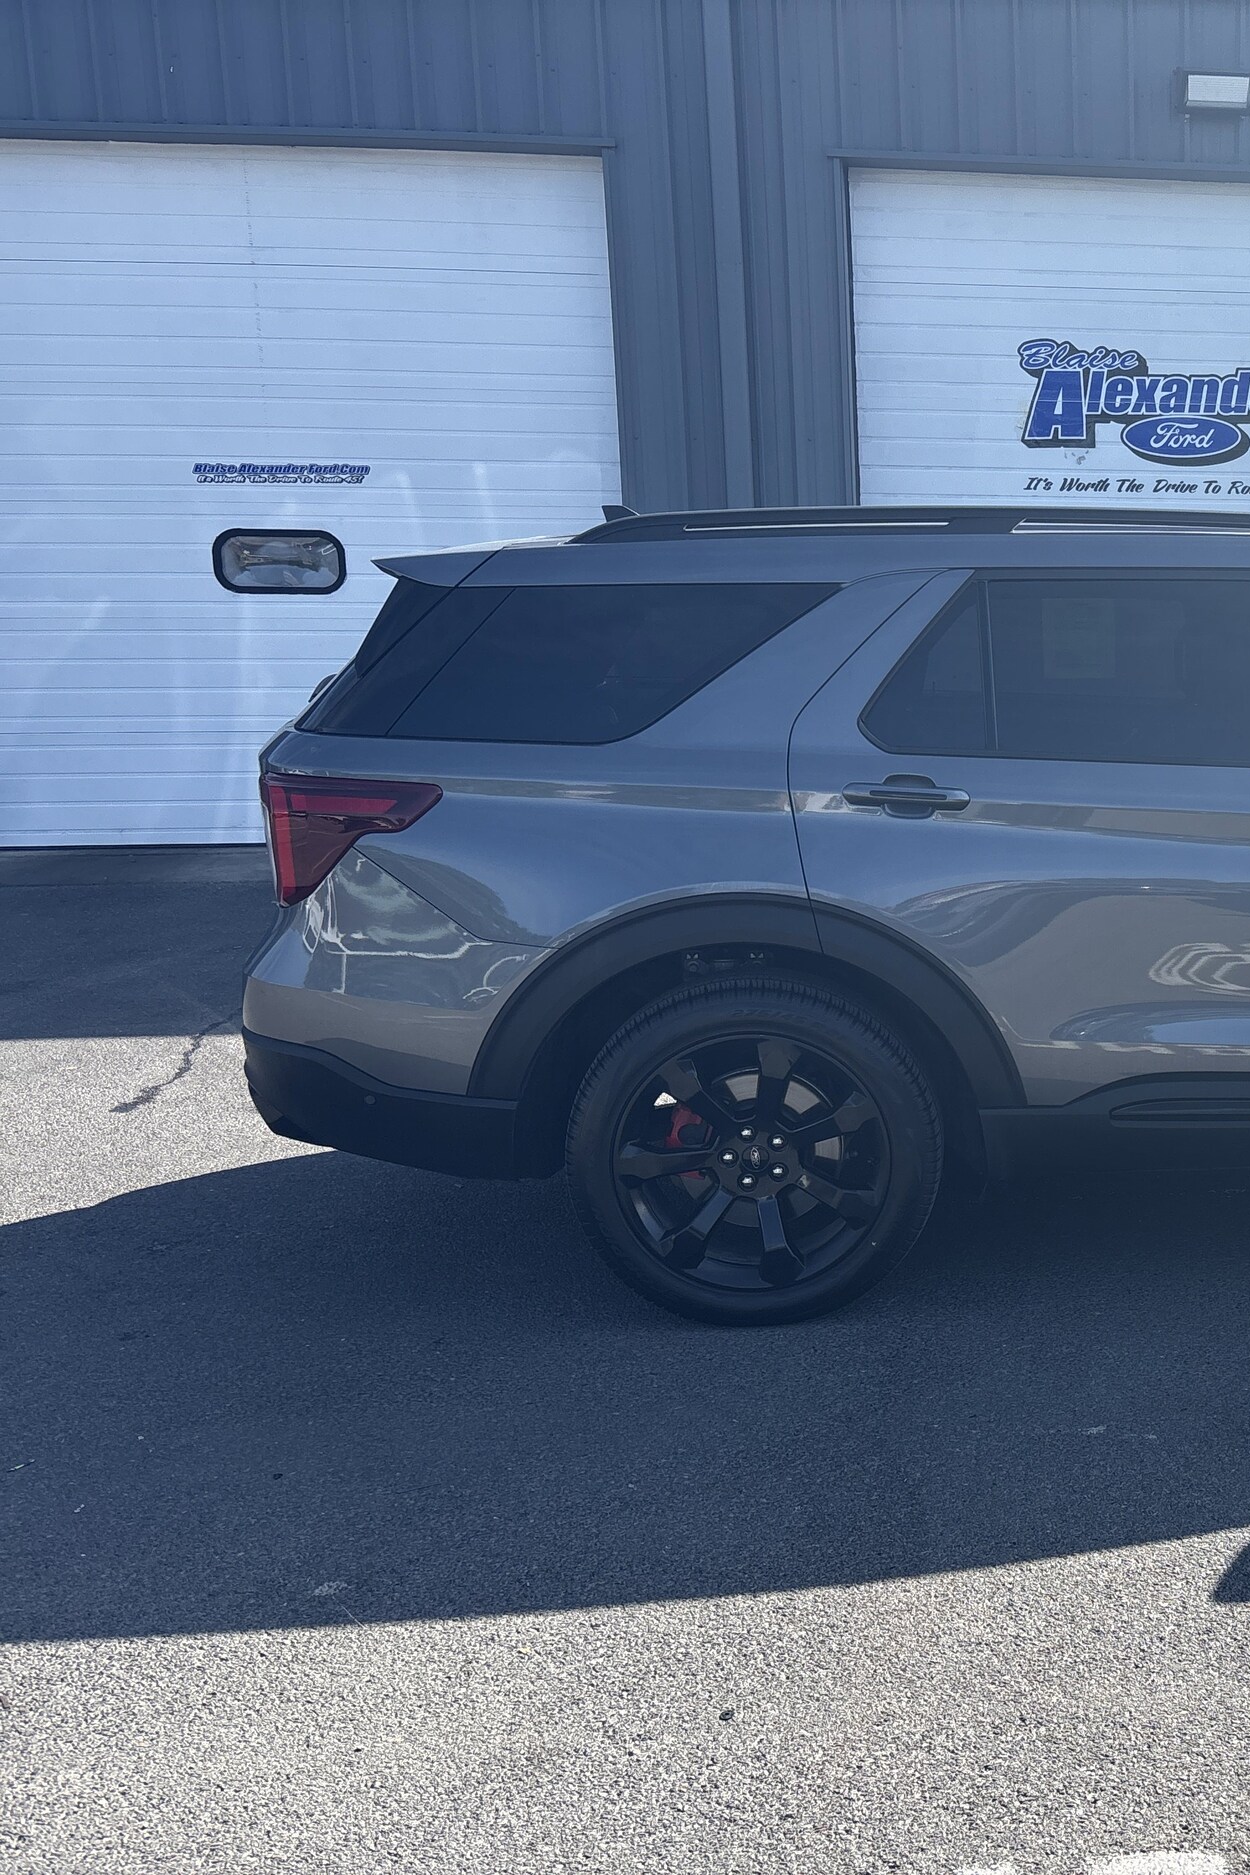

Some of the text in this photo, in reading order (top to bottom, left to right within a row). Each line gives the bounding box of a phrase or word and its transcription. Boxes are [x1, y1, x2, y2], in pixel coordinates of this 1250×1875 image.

[1018, 340, 1140, 371] Blaise
[1149, 422, 1215, 449] Ford
[192, 463, 237, 474] Blaise
[238, 463, 307, 475] Alexander
[1023, 477, 1053, 491] It's
[1060, 478, 1110, 492] Worth
[1116, 479, 1144, 493] The
[1153, 479, 1198, 494] Drive
[1203, 480, 1222, 494] To
